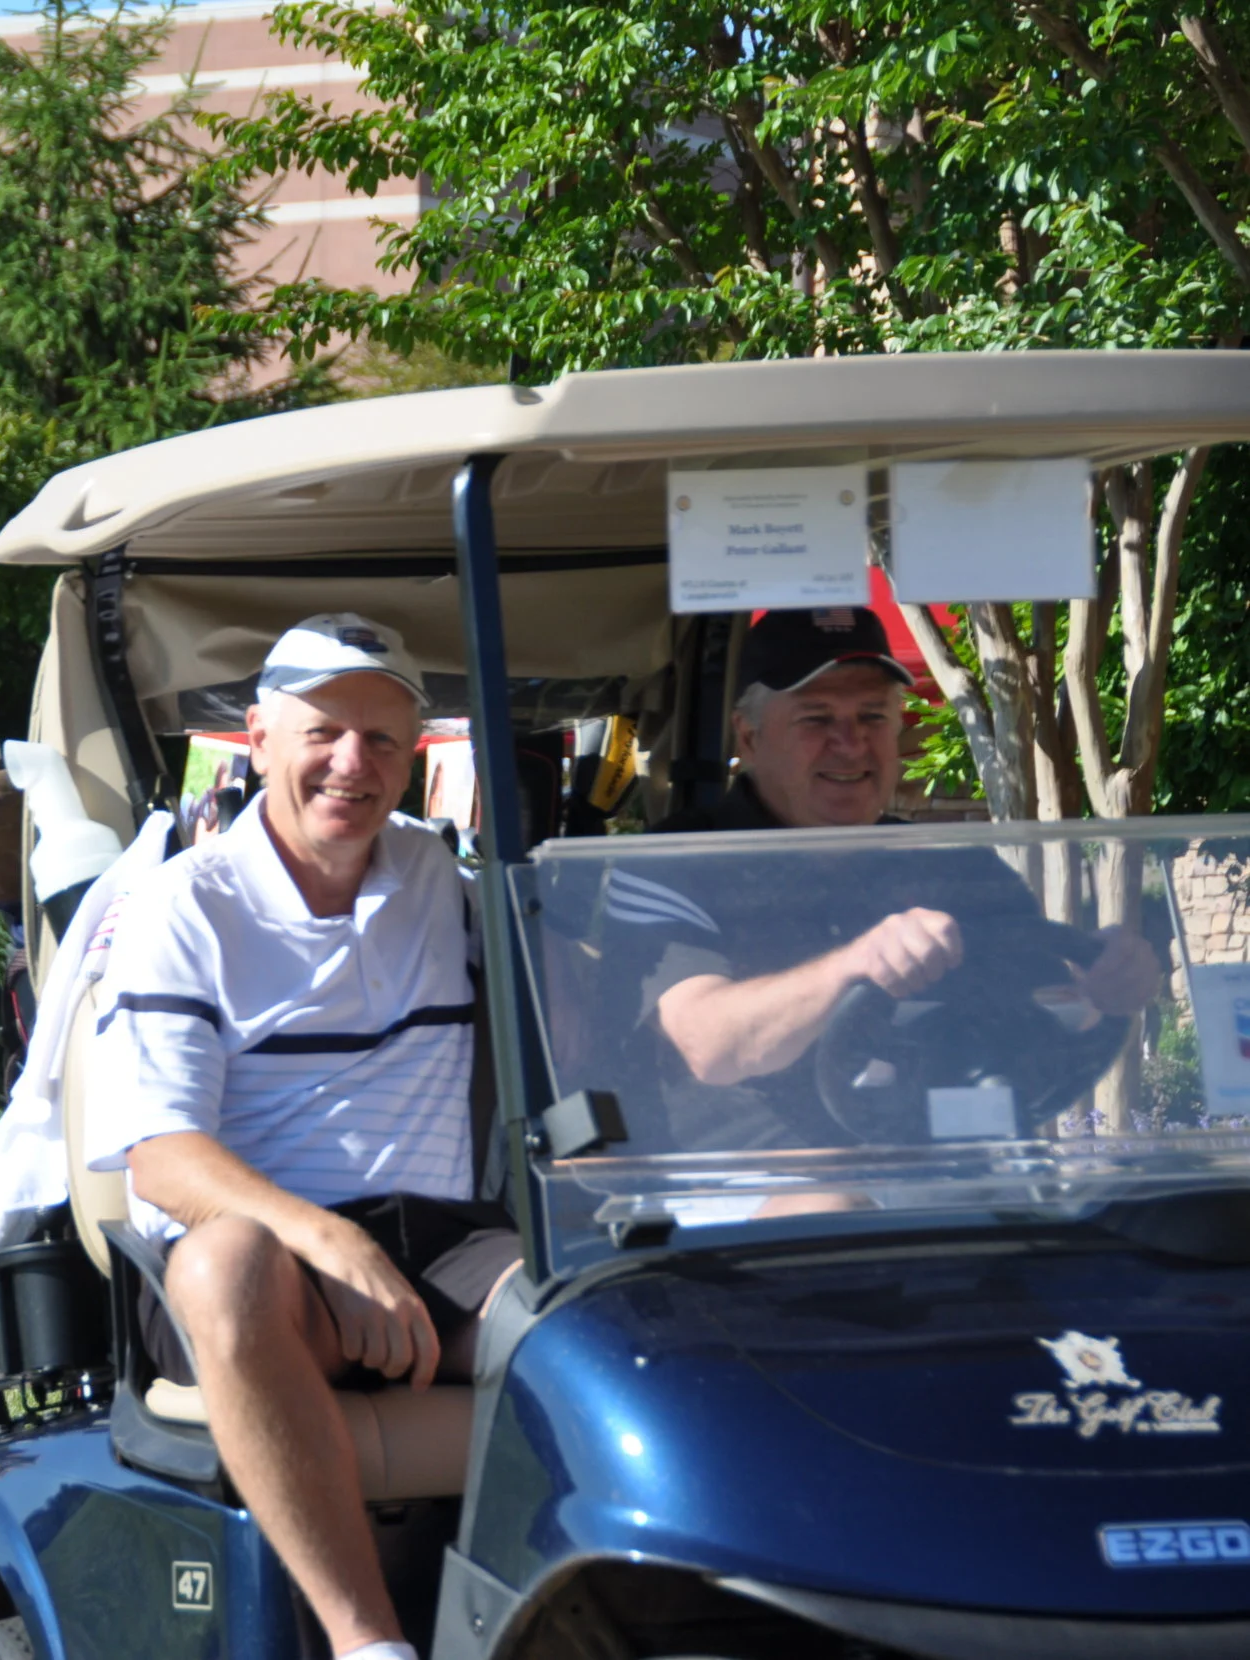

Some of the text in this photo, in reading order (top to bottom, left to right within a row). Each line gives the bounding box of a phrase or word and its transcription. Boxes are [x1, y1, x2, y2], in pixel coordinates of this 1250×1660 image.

[1008, 1390, 1222, 1437] The Golf Club
[178, 1570, 206, 1600] 47
